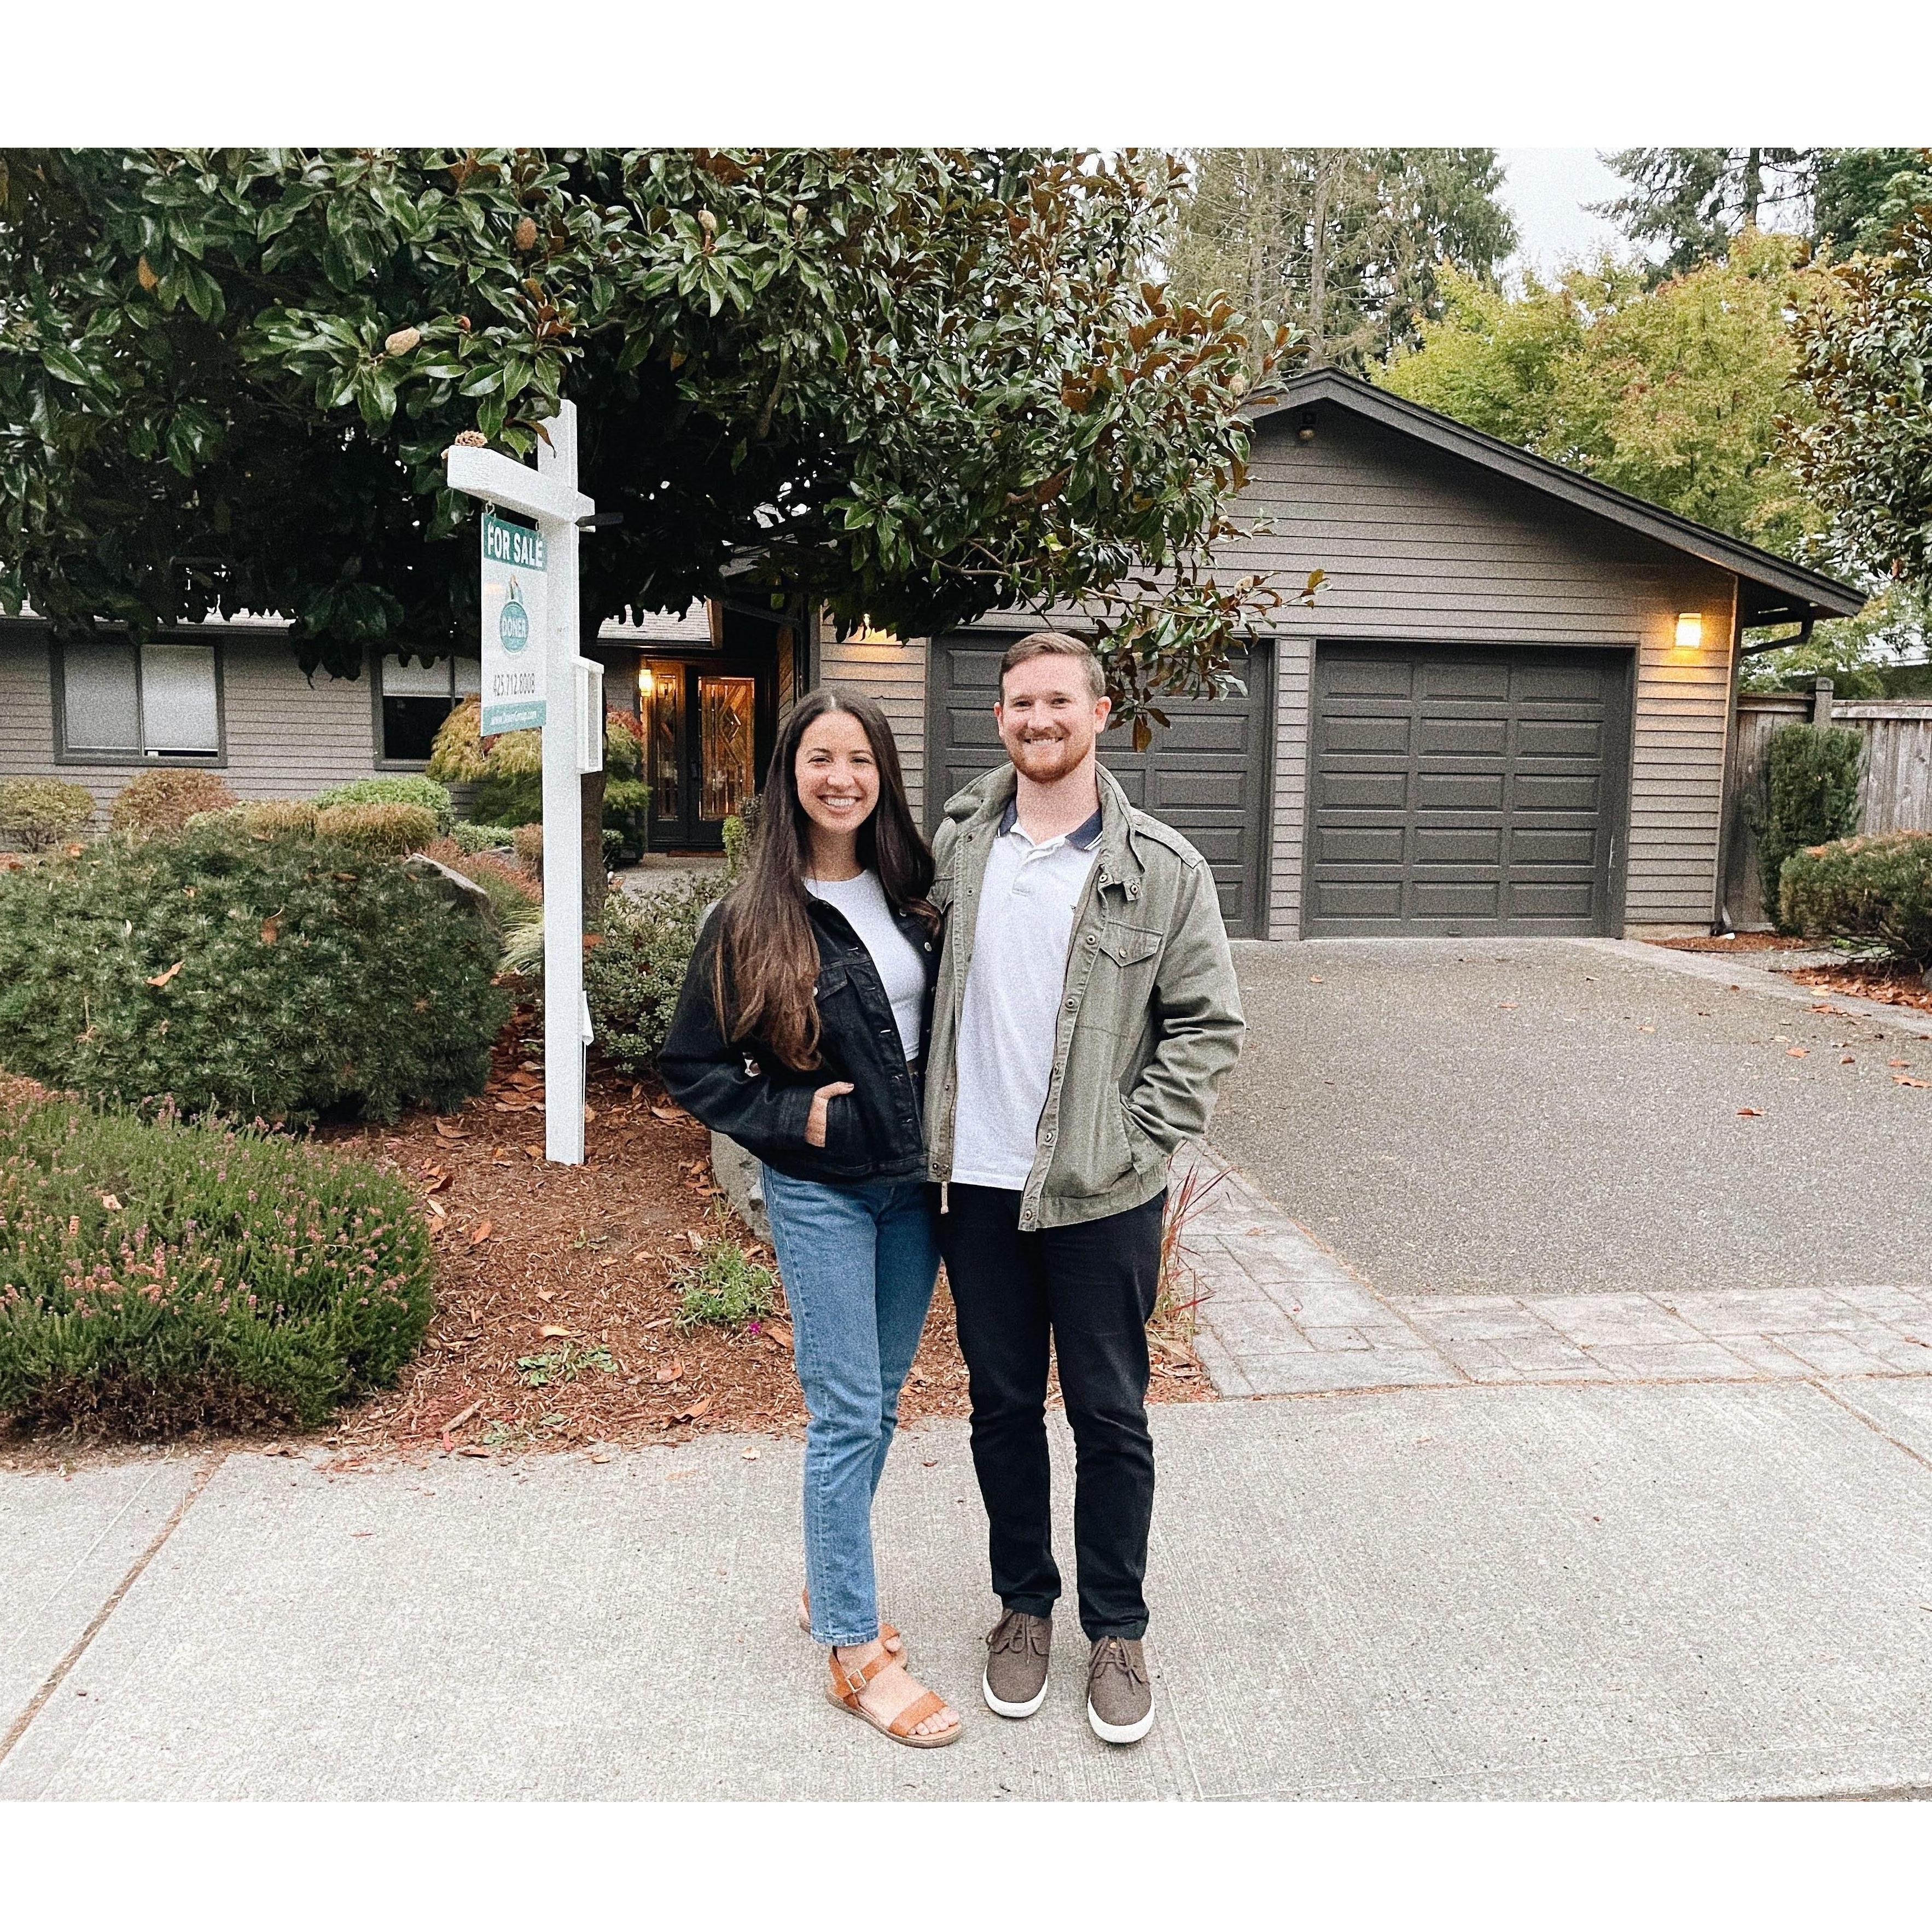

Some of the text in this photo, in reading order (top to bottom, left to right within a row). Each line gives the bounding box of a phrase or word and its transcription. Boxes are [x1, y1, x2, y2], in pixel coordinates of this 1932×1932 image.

[487, 523, 543, 567] FOR SALE
[493, 673, 535, 696] 425.712.8008
